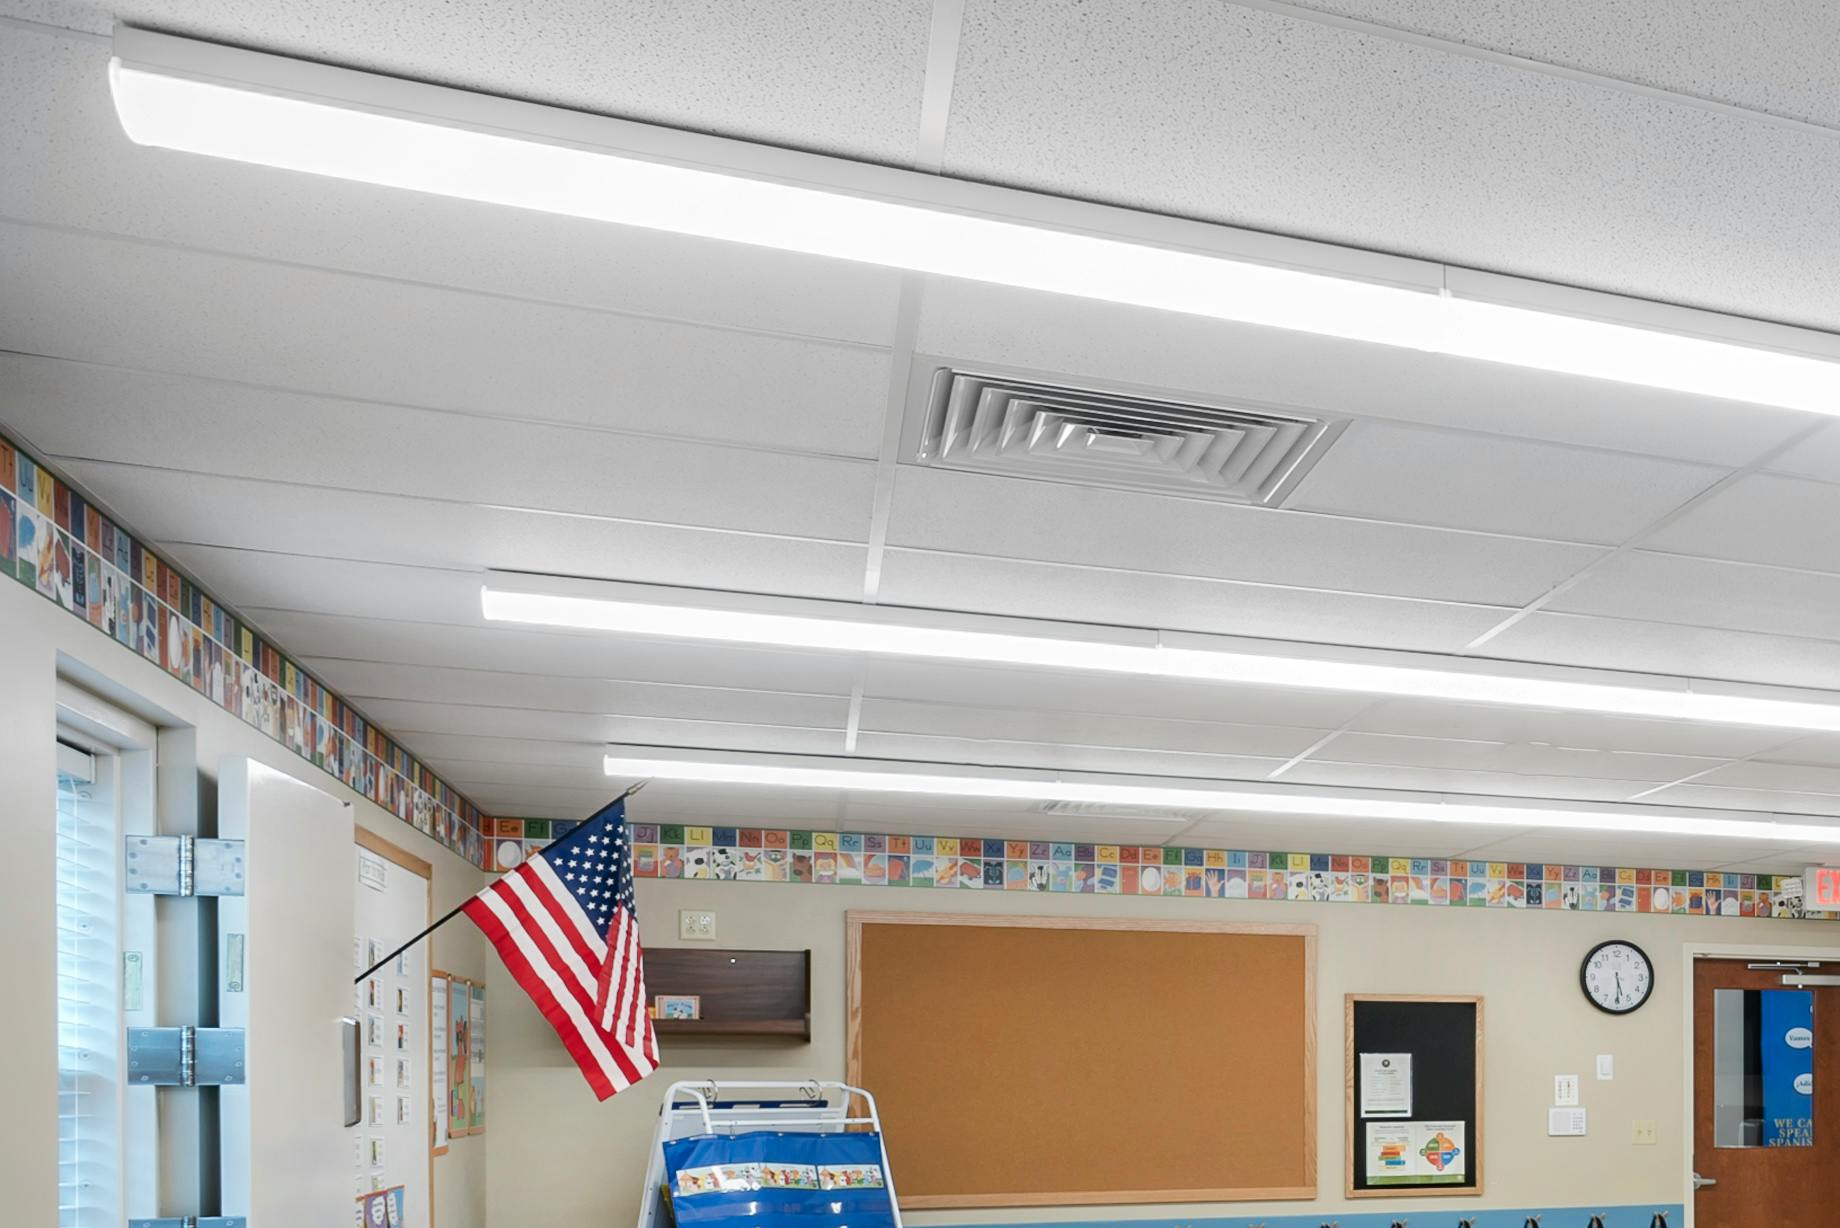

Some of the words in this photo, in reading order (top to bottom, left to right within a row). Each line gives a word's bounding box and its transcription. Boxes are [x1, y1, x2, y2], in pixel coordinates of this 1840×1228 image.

[1612, 950, 1622, 958] 12
[1594, 960, 1602, 969] 10
[1634, 961, 1640, 969] 2
[1638, 973, 1644, 982] 3
[1593, 985, 1600, 993] 8
[1774, 1118, 1793, 1128] WE
[1778, 1128, 1813, 1138] SPEA
